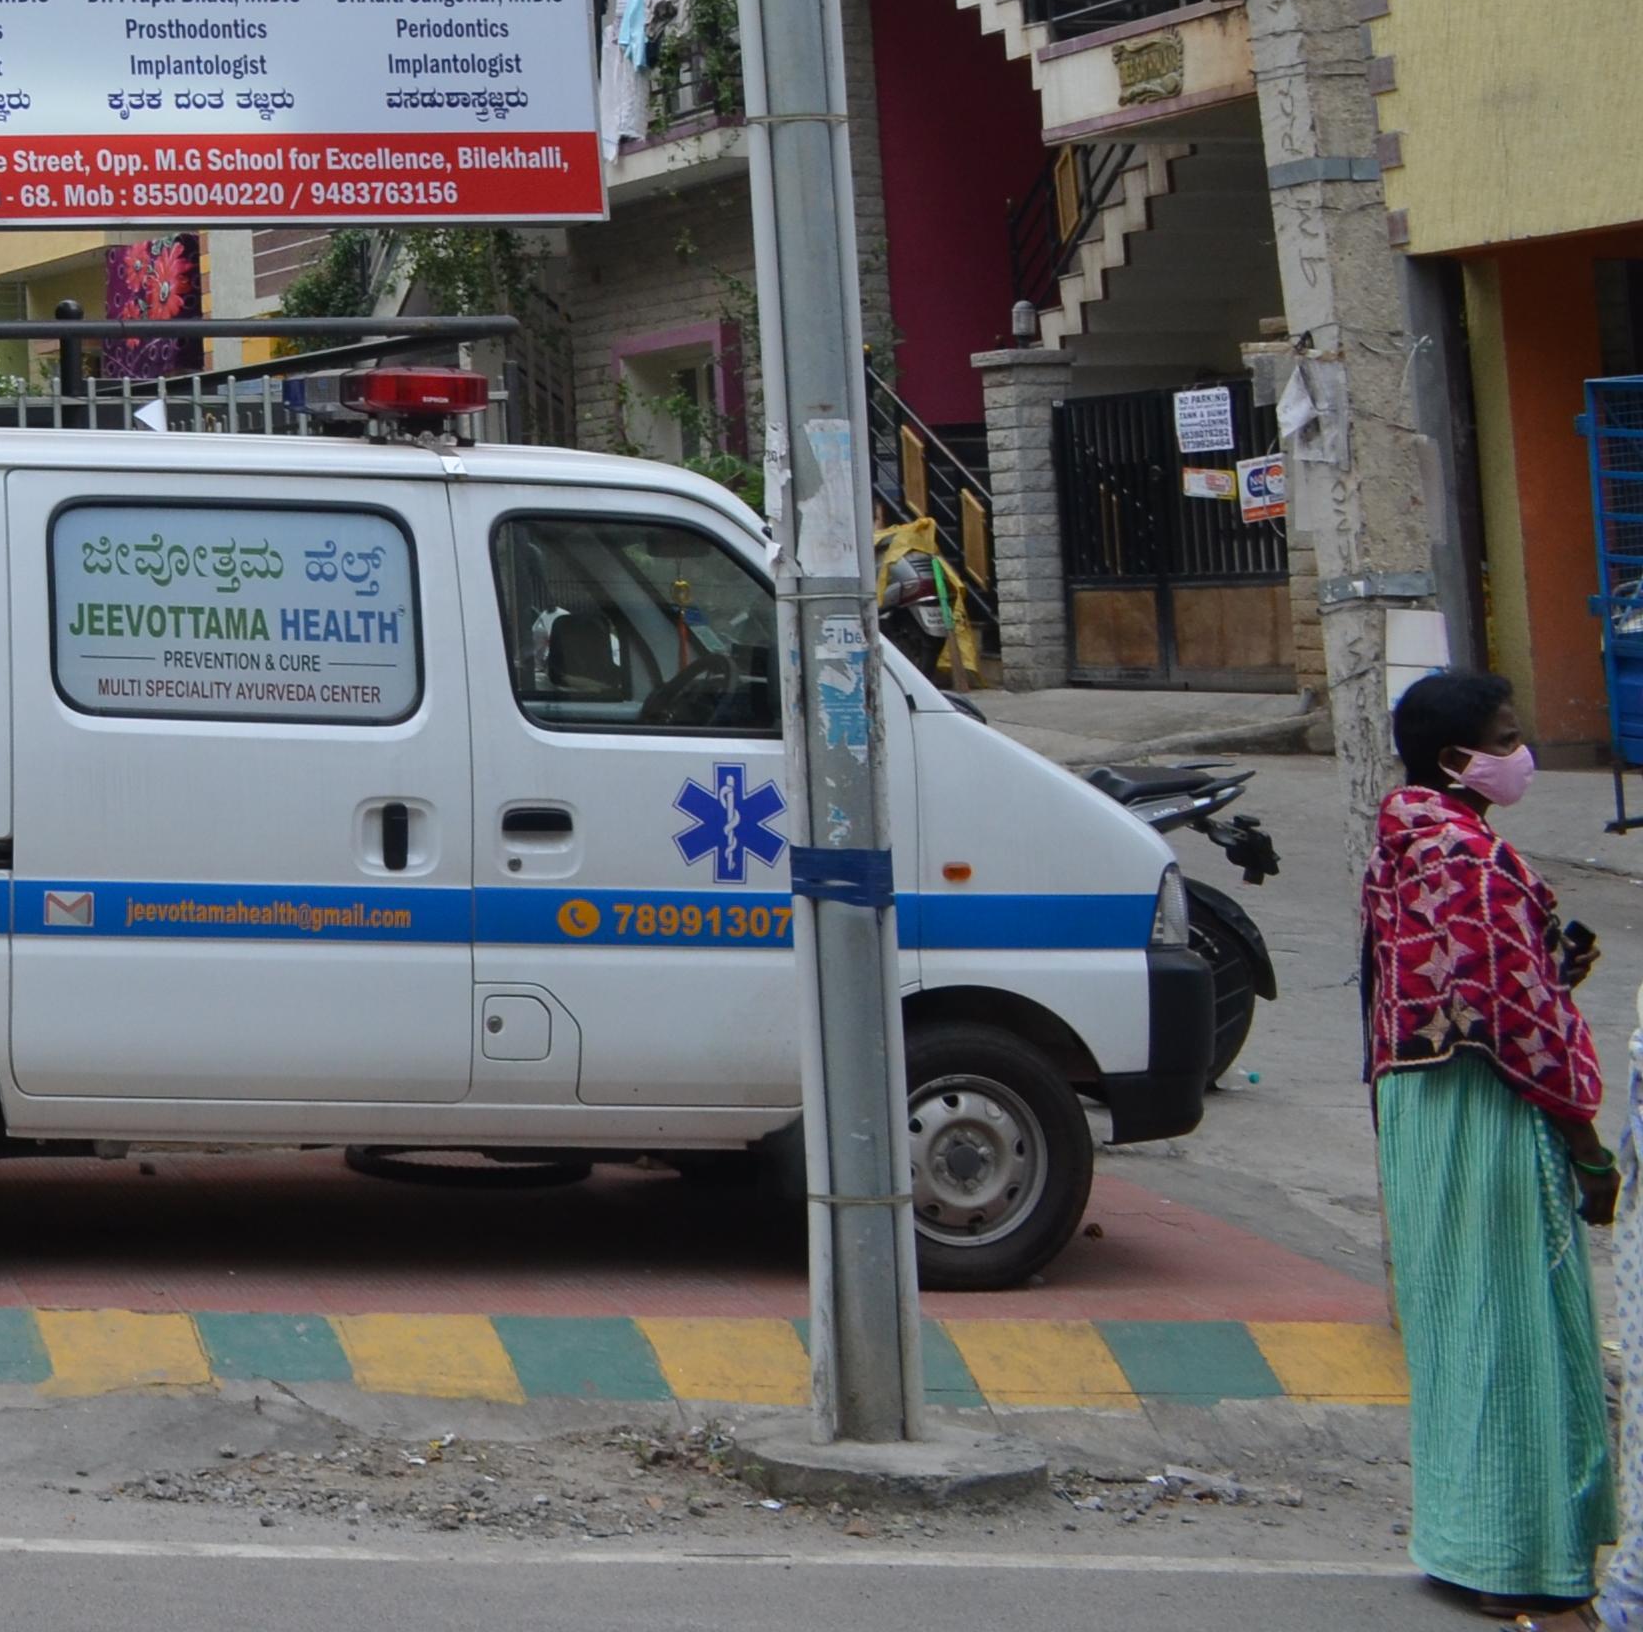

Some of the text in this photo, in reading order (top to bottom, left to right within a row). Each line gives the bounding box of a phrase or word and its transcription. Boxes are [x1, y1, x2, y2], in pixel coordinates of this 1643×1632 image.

[126, 20, 267, 40] Prosthodontics
[396, 19, 508, 40] Periodontics
[131, 55, 267, 80] Implantologist
[389, 54, 522, 78] Implantologist
[175, 88, 223, 109] ದಂತ
[14, 151, 90, 177] Street,
[97, 150, 148, 176] Opp.
[156, 150, 201, 171] M.G
[207, 149, 283, 171] School
[289, 148, 320, 171] for
[326, 148, 451, 174] Excellence,
[458, 147, 568, 172] Bilekhalli,
[21, 187, 58, 208] 68.
[65, 184, 114, 206] Mob
[133, 183, 284, 206] 8550040220
[311, 181, 457, 204] 9483763156
[69, 603, 398, 644] JEEVOTTAMA HEALTH
[165, 651, 321, 672] PREVENTION CURE
[98, 678, 380, 703] MULTI SPECIALITY AYURVEDA CENTER
[126, 897, 792, 938] jeevottamahealth@gmail.com 78991307
